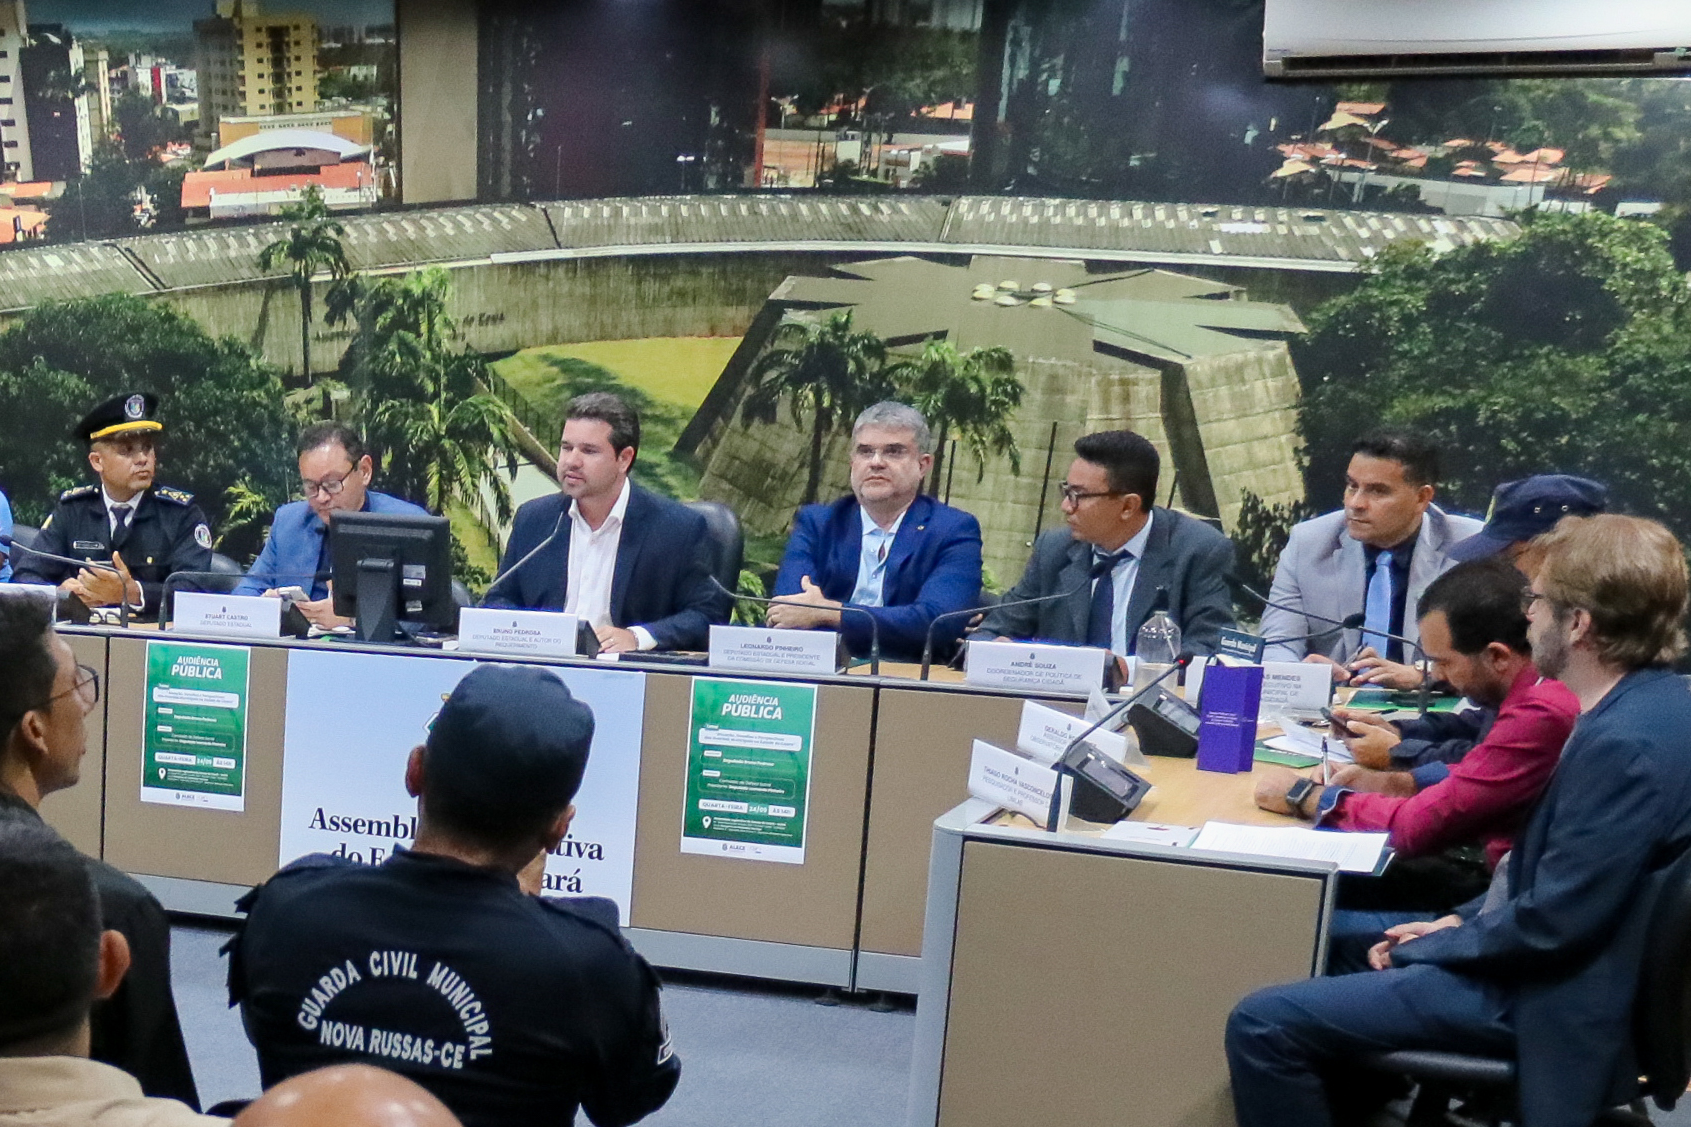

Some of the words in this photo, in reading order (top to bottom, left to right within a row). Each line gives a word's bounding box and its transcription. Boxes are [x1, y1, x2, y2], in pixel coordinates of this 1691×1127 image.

[176, 655, 219, 667] AUDIÊNCIA
[171, 662, 222, 680] PÚBLICA
[728, 693, 779, 706] AUDIÊNCIA
[721, 701, 782, 720] PÚBLICA
[308, 806, 417, 840] Assembl
[297, 959, 362, 1030] GUARDA
[369, 950, 418, 979] CIVIL
[426, 961, 493, 1060] MUNICIPAL
[319, 1020, 365, 1051] NOVA
[368, 1028, 466, 1069] RUSSAS-CE
